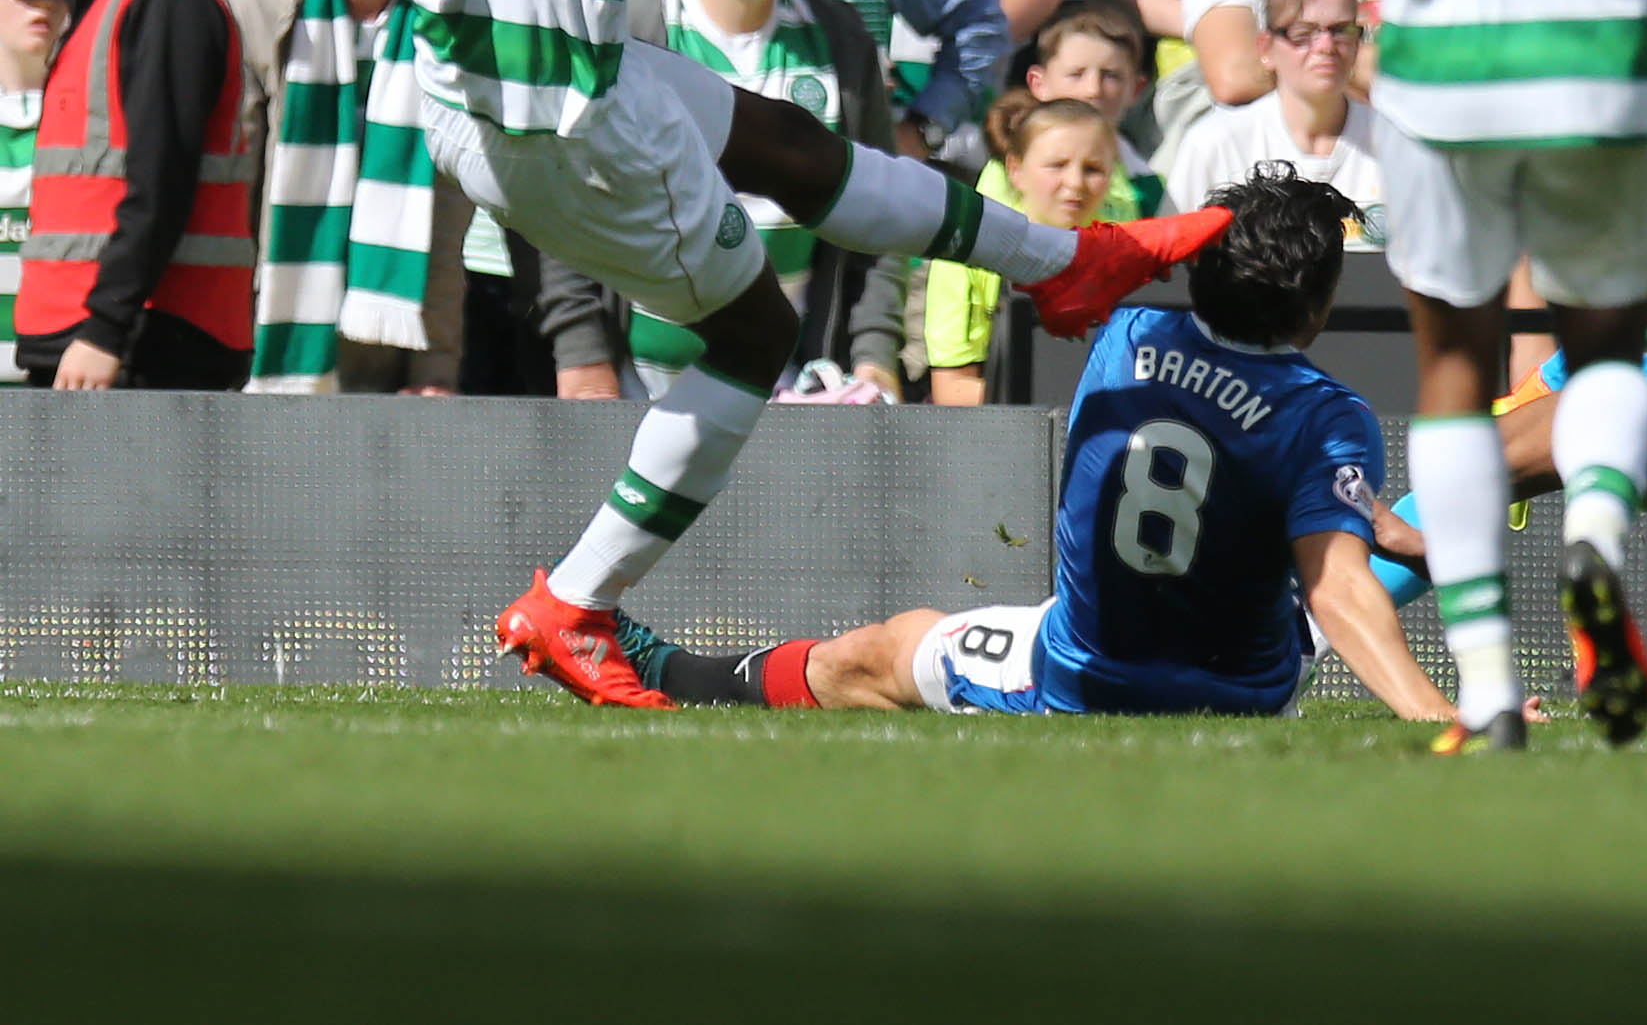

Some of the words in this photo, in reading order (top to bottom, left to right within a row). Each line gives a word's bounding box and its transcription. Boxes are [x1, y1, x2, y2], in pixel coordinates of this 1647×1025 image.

[1134, 346, 1272, 431] BARTON
[1110, 418, 1216, 577] 8
[959, 625, 1014, 664] 8
